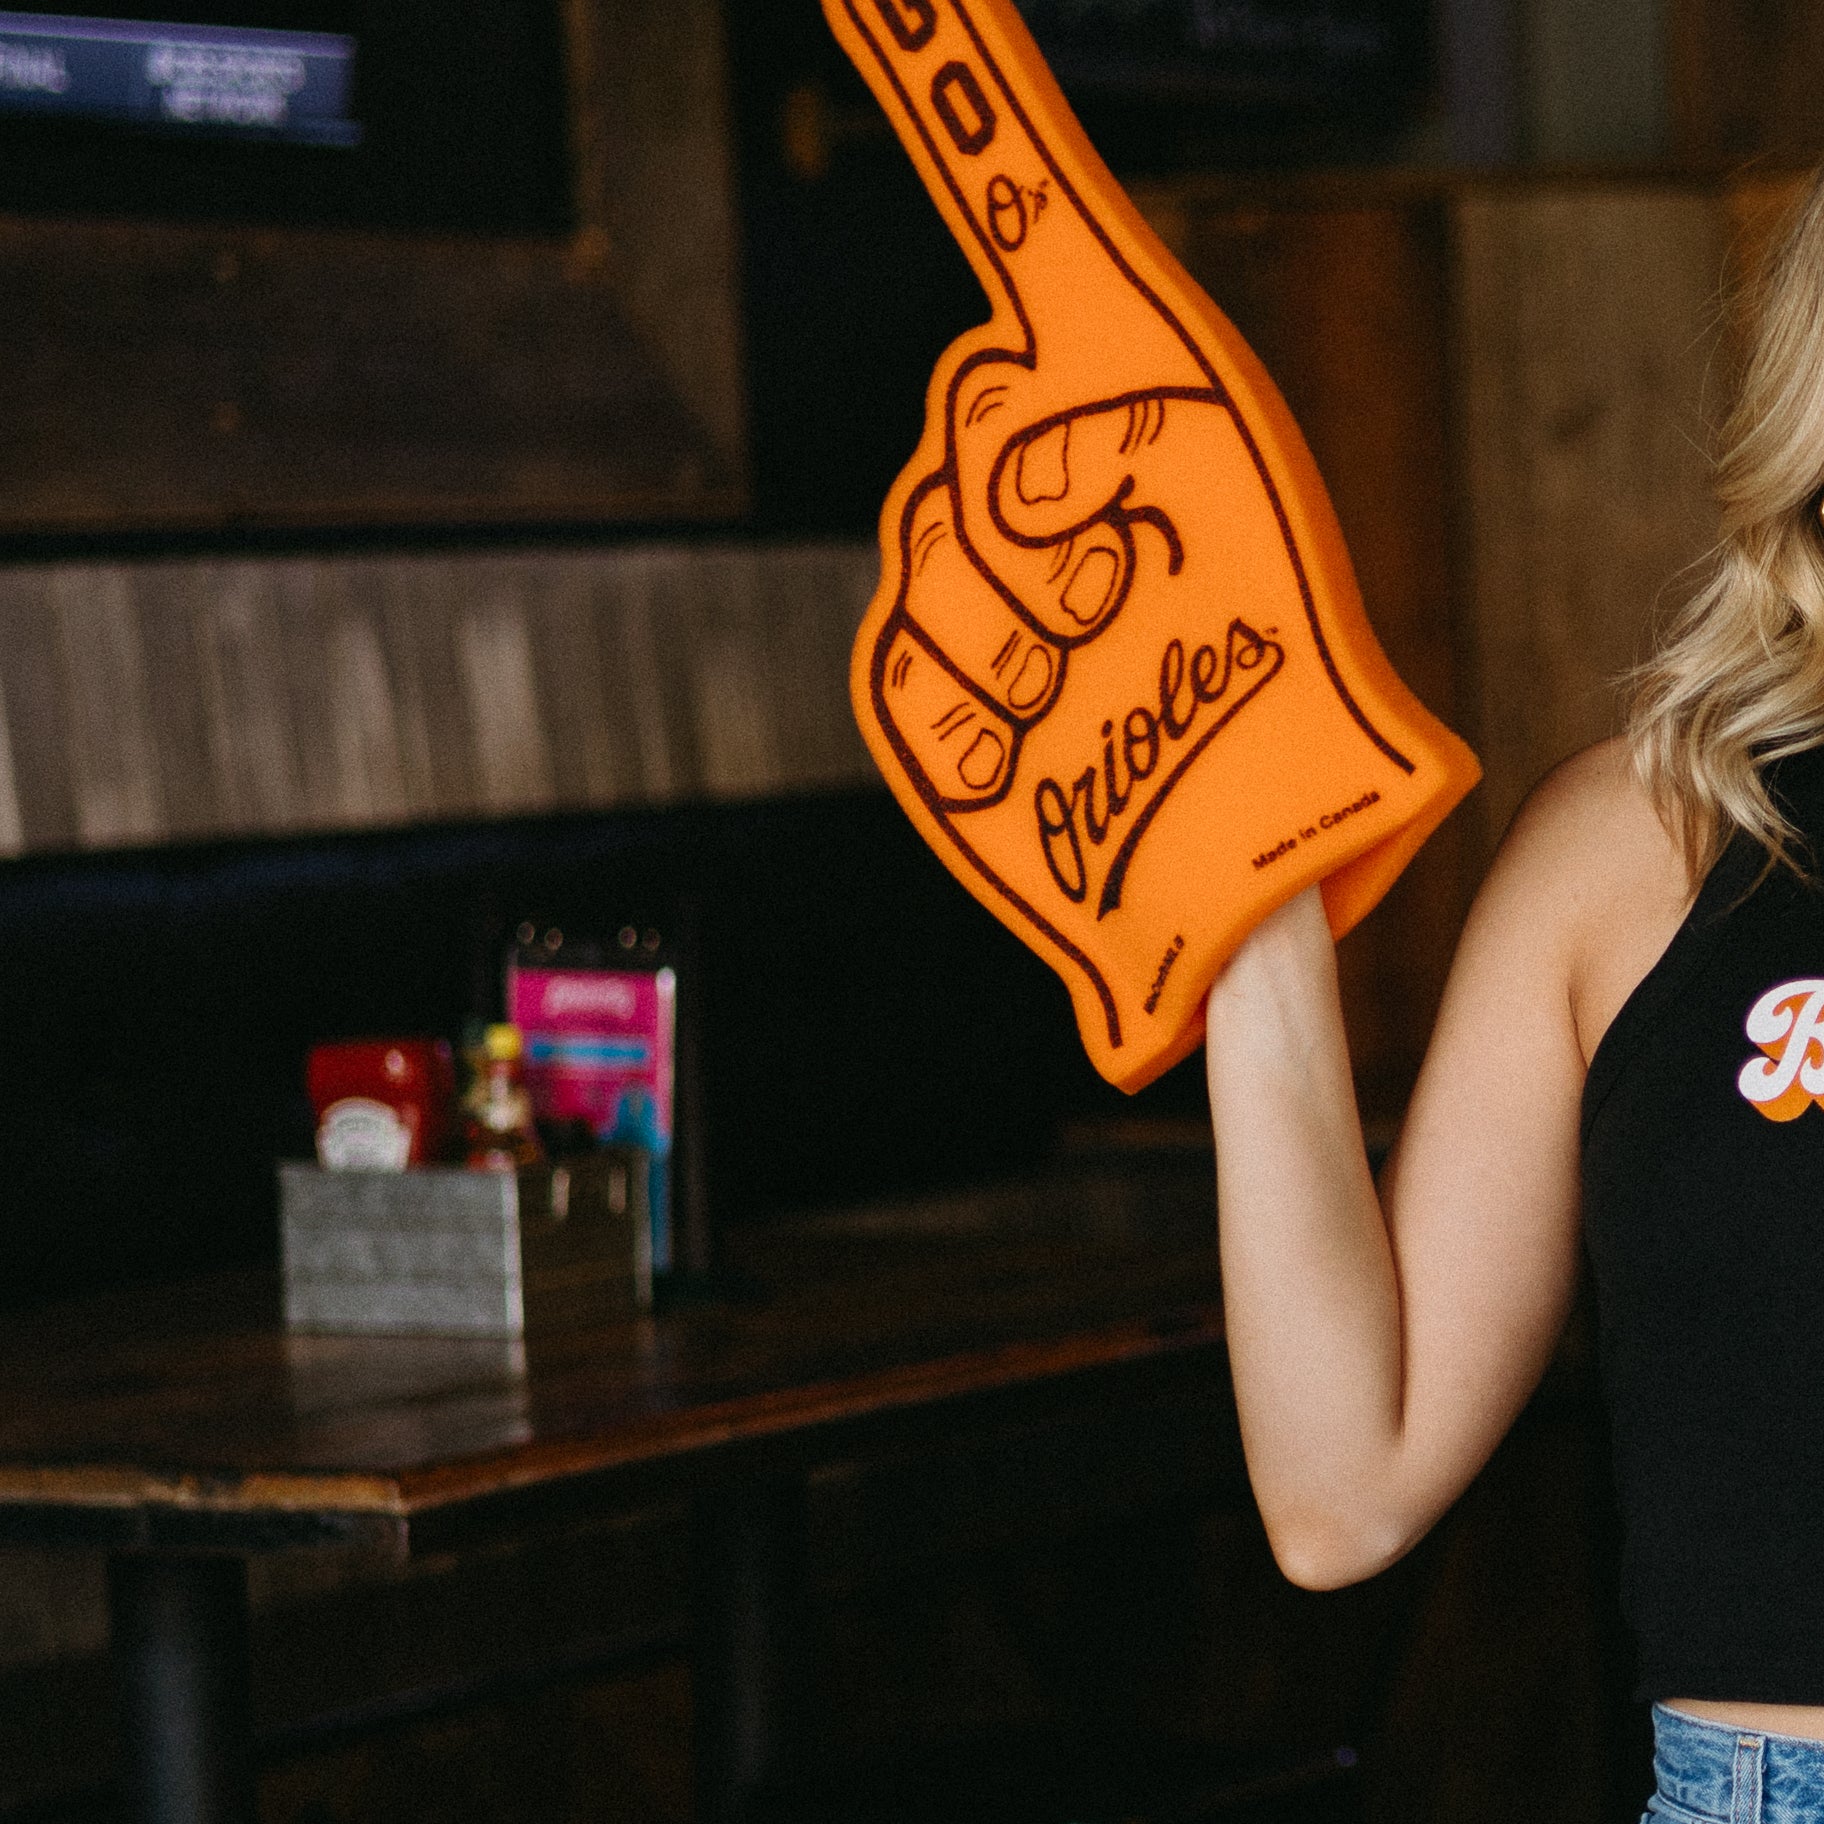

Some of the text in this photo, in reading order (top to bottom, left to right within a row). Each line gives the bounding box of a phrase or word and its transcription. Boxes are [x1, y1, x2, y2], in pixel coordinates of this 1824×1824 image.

[1034, 617, 1283, 911] Orioles
[1252, 790, 1382, 871] Made in Canada
